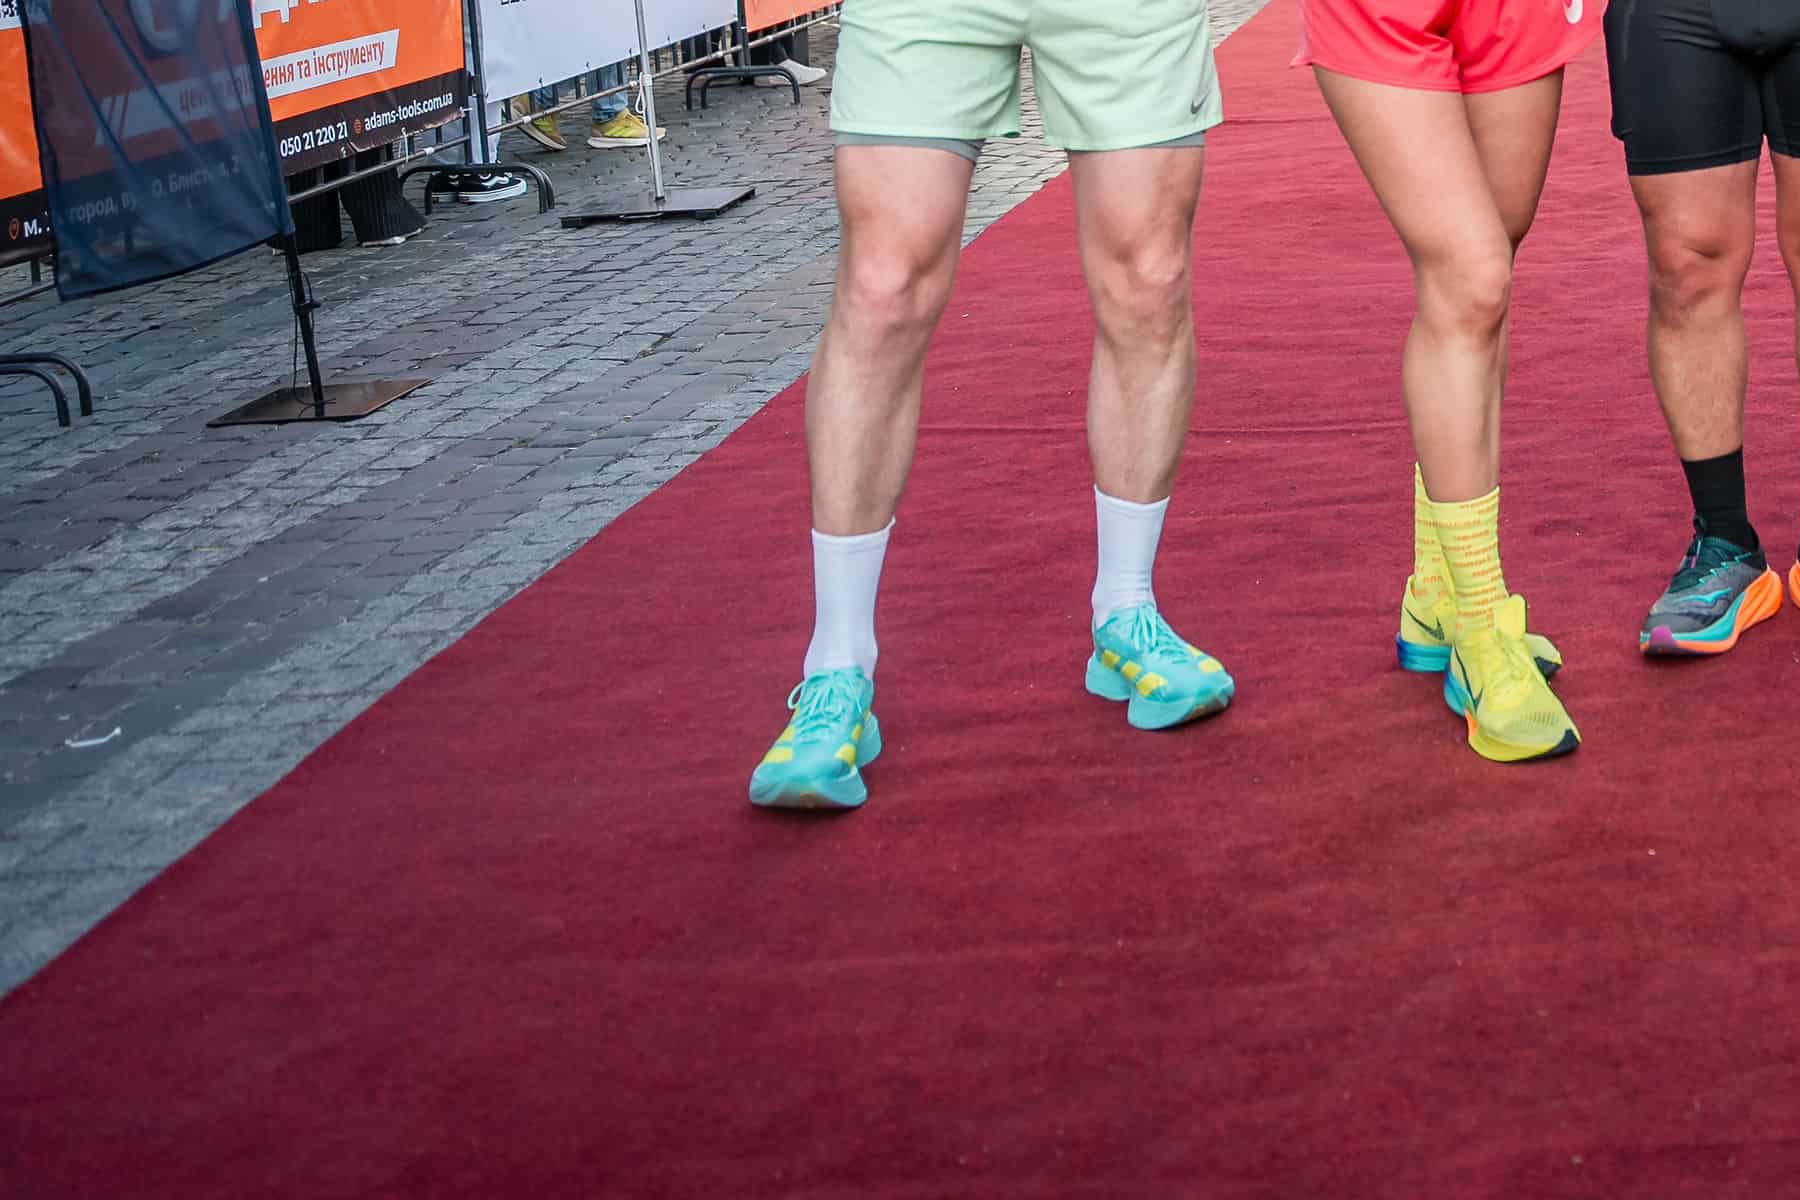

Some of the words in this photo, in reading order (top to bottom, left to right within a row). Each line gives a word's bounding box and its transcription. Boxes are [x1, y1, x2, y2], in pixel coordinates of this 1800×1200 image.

[264, 64, 294, 89] ення
[297, 59, 311, 79] та
[313, 40, 385, 78] інструменту
[280, 138, 301, 158] 050
[304, 133, 314, 150] 21
[317, 127, 336, 146] 220
[337, 121, 348, 139] 21
[364, 92, 453, 131] adams-tools.com.ua
